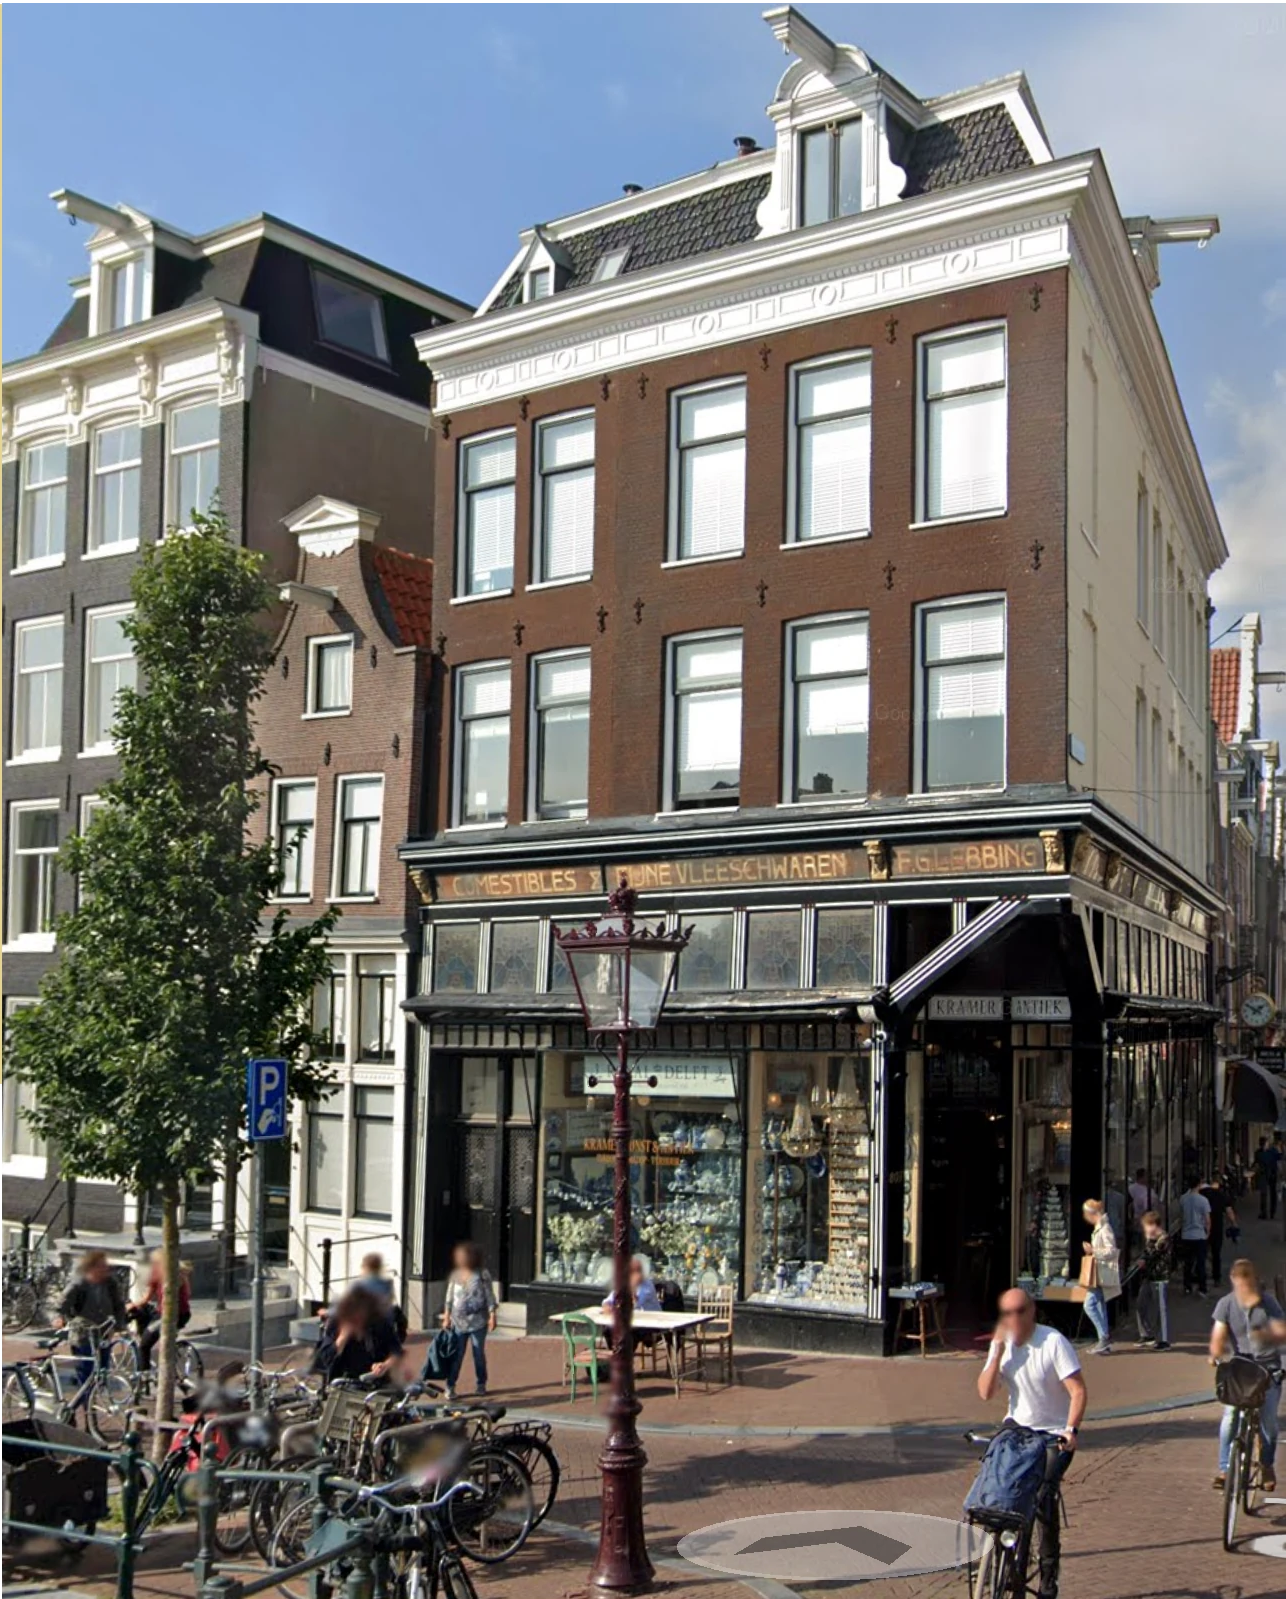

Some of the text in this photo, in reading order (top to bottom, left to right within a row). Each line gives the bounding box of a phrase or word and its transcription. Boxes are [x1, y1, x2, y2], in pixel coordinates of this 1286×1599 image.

[676, 853, 848, 885] VLEESCHWAREN
[936, 998, 997, 1016] KRAMER
[606, 1063, 710, 1081] RAL DELFT
[260, 1065, 280, 1106] P
[584, 1138, 616, 1151] KRAME
[628, 1140, 651, 1153] UNST
